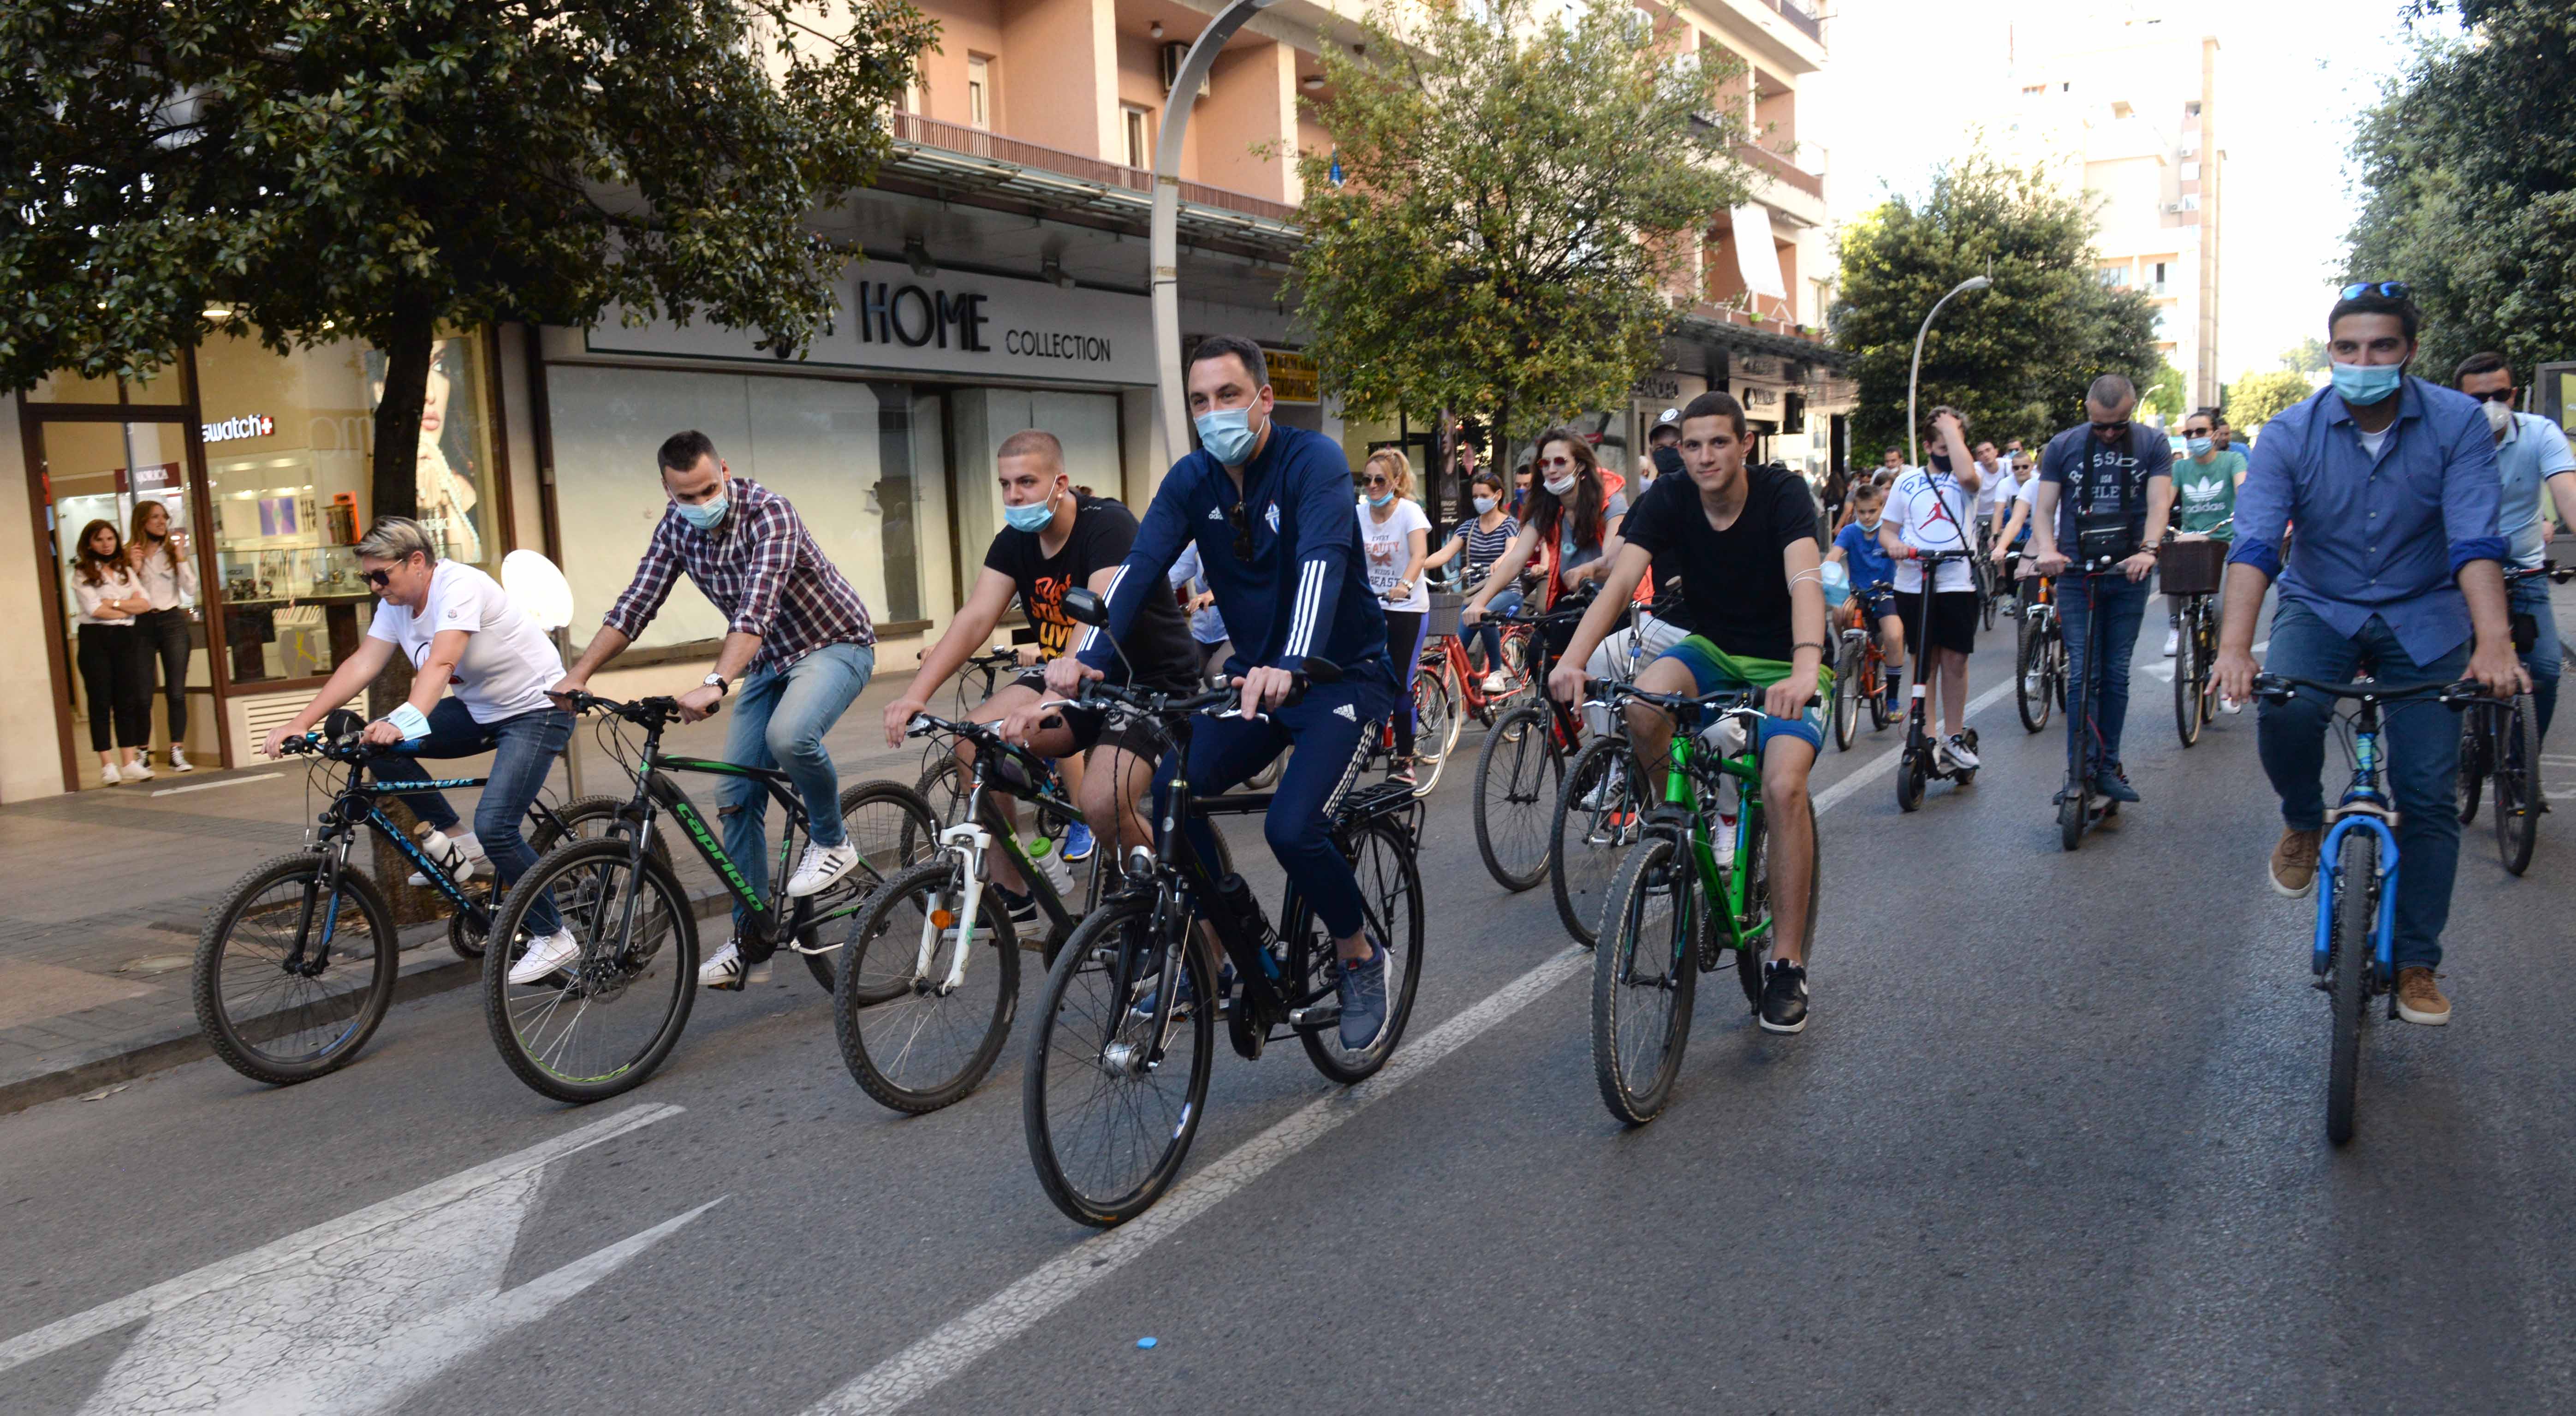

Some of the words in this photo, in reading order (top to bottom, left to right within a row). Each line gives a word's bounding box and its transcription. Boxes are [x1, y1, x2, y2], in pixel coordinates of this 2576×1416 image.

[861, 280, 991, 352] HOME
[1005, 329, 1111, 363] COLLECTION
[2185, 501, 2226, 513] adidas
[1333, 708, 1357, 722] adidas
